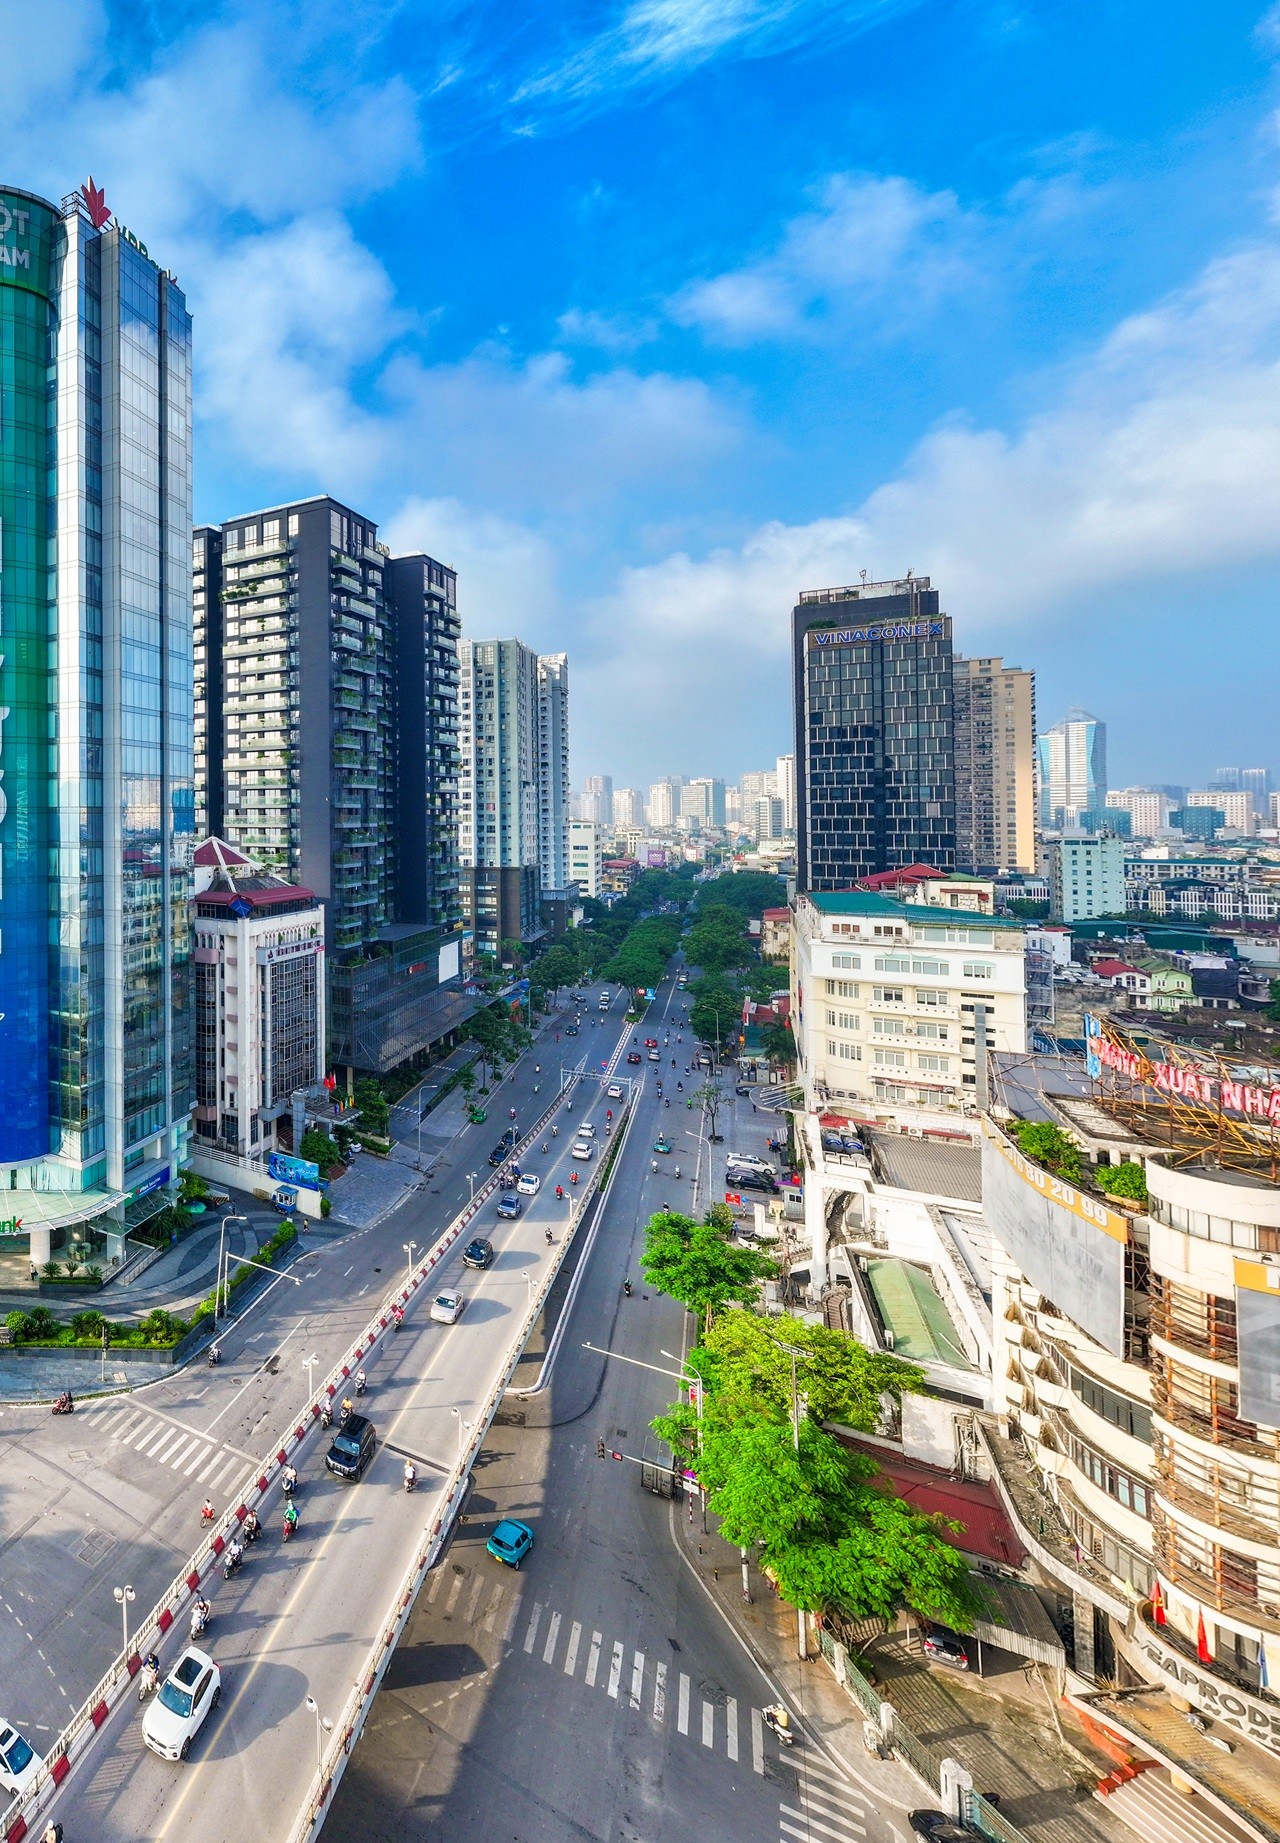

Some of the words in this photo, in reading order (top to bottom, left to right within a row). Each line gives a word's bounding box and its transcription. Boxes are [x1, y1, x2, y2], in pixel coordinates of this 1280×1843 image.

[815, 622, 944, 645] VINACONEX
[1153, 1061, 1215, 1103] XUẤT
[1026, 1169, 1045, 1189] 80
[1050, 1180, 1075, 1206] 20
[1081, 1196, 1108, 1227] 99
